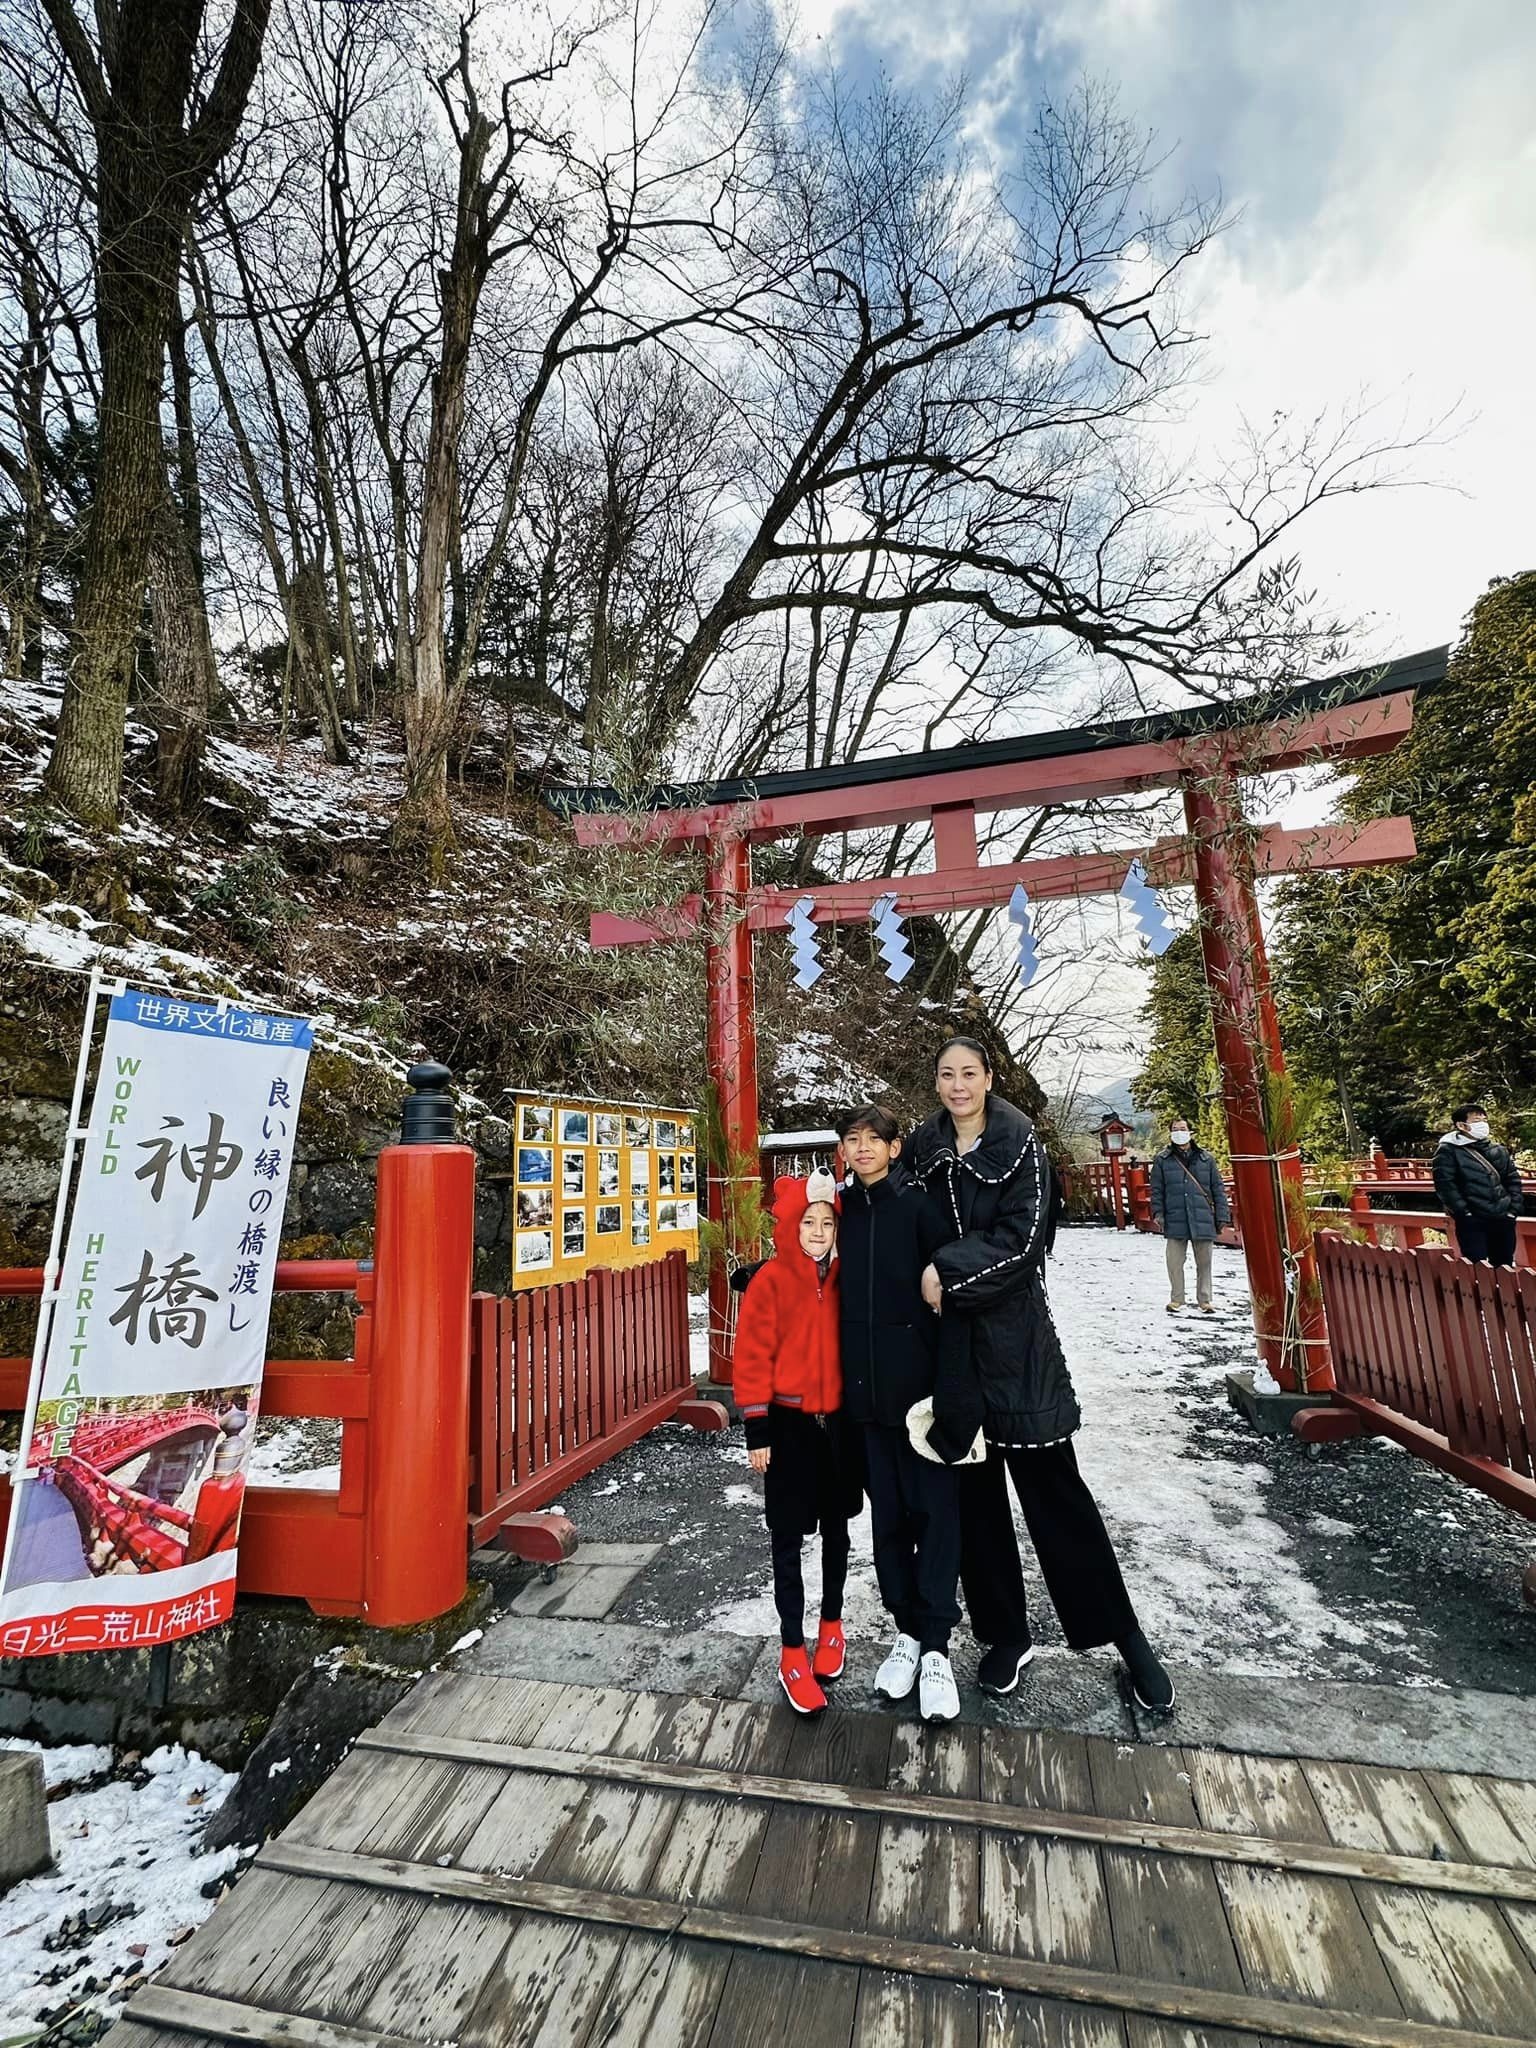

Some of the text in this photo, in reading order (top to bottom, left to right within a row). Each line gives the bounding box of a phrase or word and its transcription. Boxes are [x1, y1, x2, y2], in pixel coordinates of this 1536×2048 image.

[136, 998, 295, 1042] 世界文化遺産
[51, 1056, 142, 1457] WORLD HERITAGE
[109, 1112, 244, 1349] 神橋
[228, 1077, 291, 1332] 良い縁の橋渡し
[3, 1590, 221, 1654] 日光二荒山神社
